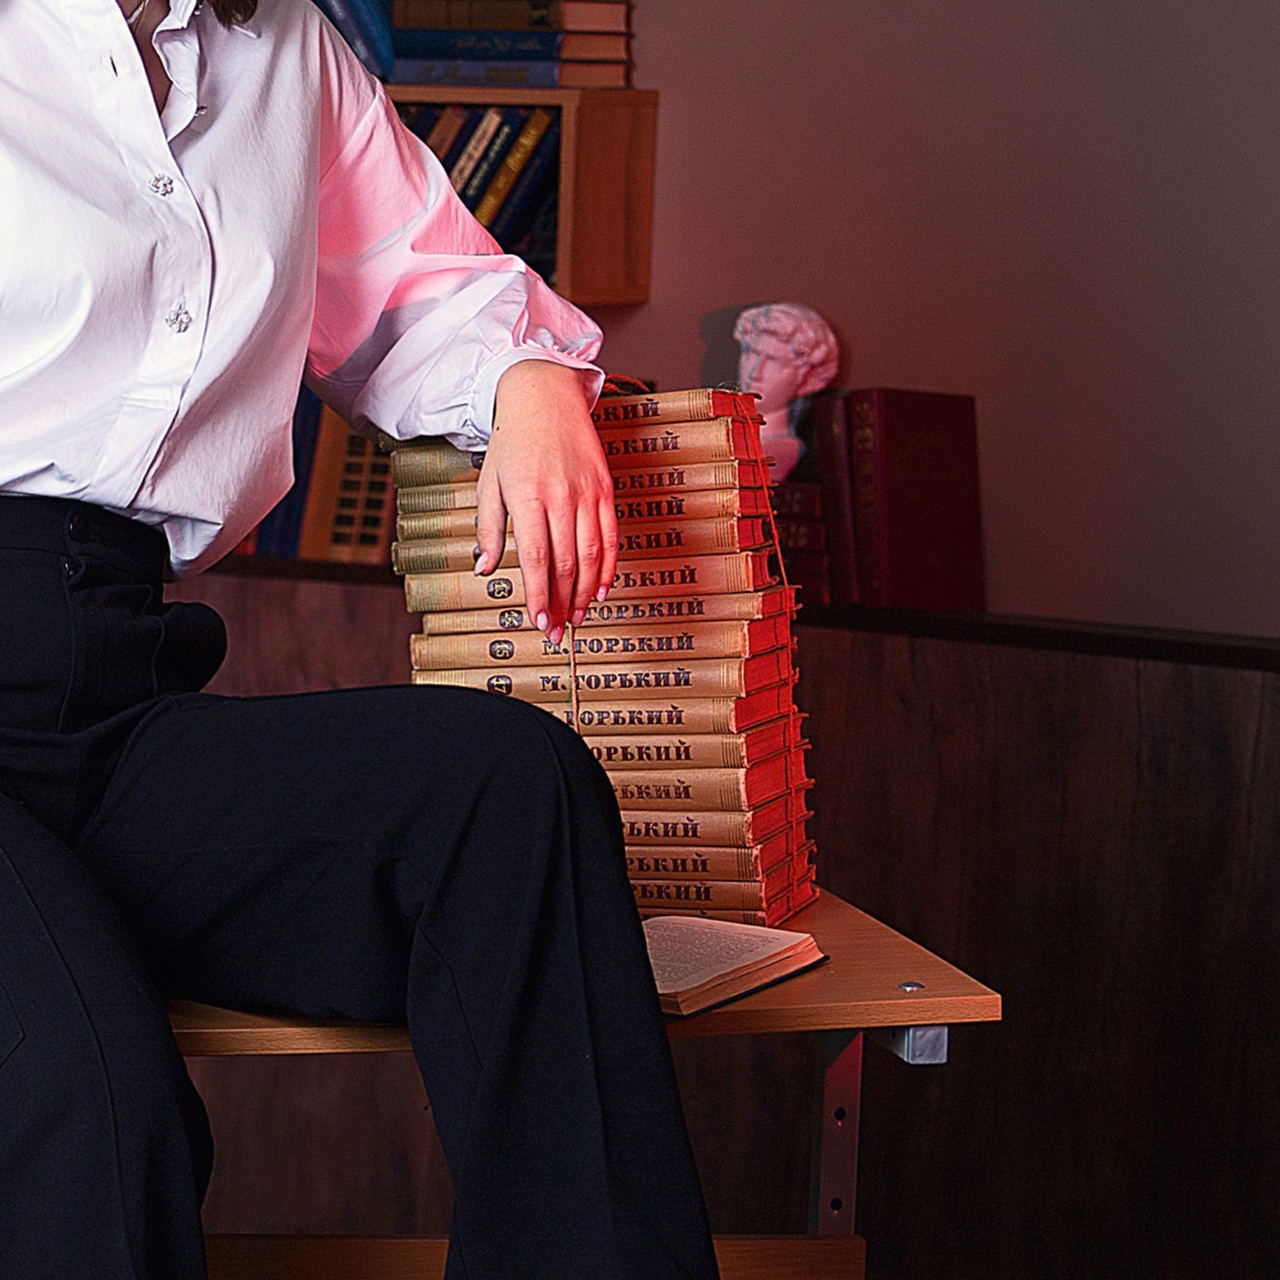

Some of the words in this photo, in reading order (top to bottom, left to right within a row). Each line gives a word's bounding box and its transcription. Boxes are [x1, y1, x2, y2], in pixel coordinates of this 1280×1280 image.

[590, 398, 661, 423] ЬКИЙ
[607, 430, 680, 455] ЬКИЙ
[613, 467, 686, 489] ЬКИЙ
[614, 495, 685, 519] ЬКИЙ
[617, 527, 683, 550] ЬКИЙ
[613, 564, 697, 589] РЬКИЙ
[583, 596, 704, 622] ГОРЬКИЙ
[574, 630, 694, 654] ГОРЬКИЙ
[576, 667, 692, 690] ГОРЬКИЙ
[593, 738, 692, 762] ОРЬКИЙ
[613, 778, 693, 800] ЬКИЙ
[624, 816, 700, 838] ЬКИЙ
[626, 851, 710, 873] РЬКИЙ
[632, 881, 713, 902] РЬКИЙ
